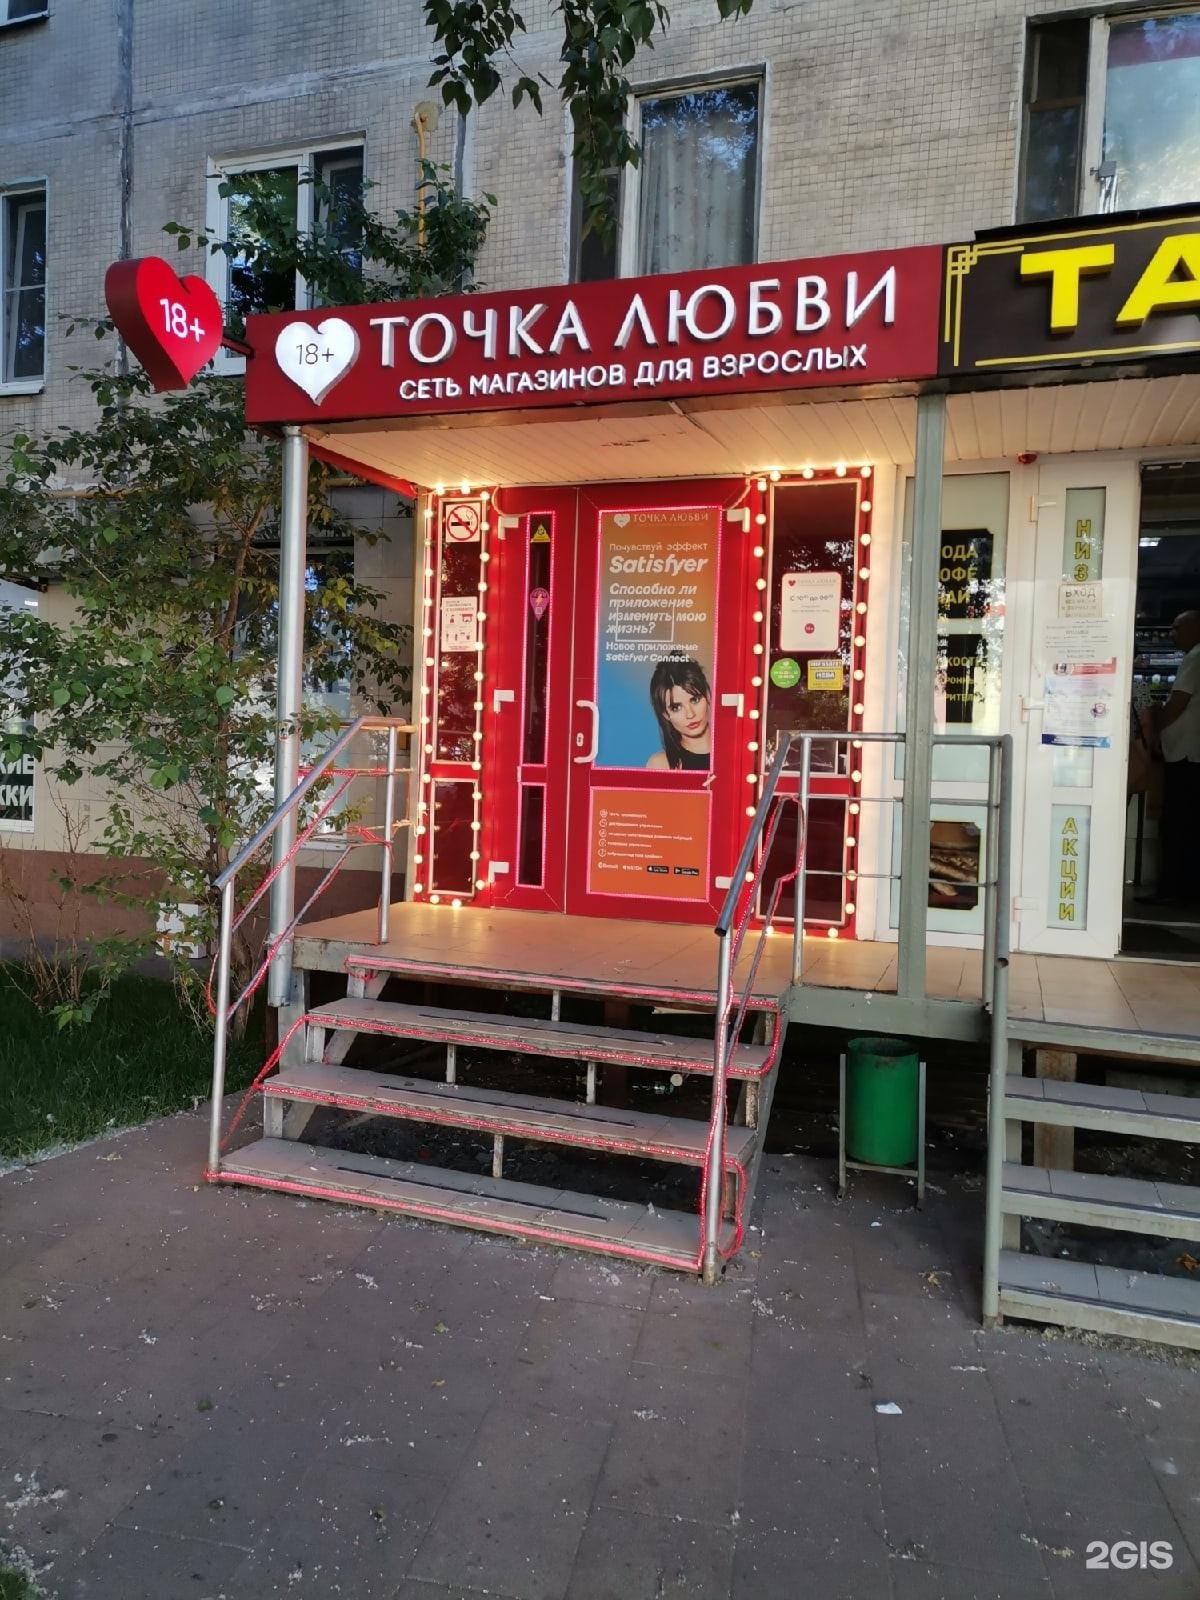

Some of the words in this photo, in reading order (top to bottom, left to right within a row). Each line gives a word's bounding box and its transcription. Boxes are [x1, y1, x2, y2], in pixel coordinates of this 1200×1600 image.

[160, 298, 206, 343] 18+
[369, 300, 592, 368] ТОЧКА
[614, 265, 897, 349] ЛЮБВИ
[296, 343, 335, 365] 18+
[400, 377, 461, 400] СЕТЬ
[469, 364, 625, 395] МАГАЗИНОВ
[633, 358, 693, 387] ДЛЯ
[703, 344, 868, 379] ВЗРОСЛЫХ
[633, 513, 667, 523] ТОЧКА
[669, 512, 709, 522] ЛЮБВИ
[609, 542, 662, 553] Почувствуй
[666, 541, 708, 553] эффект
[941, 545, 979, 561] ОДА
[609, 553, 709, 577] Satisfyer
[940, 566, 978, 581] ОФЕ
[609, 583, 676, 595] Способно
[678, 584, 698, 595] ли
[608, 598, 695, 609] приложение
[607, 611, 673, 622] изменить
[675, 611, 707, 622] мою
[606, 621, 656, 634] жизнь?
[605, 641, 636, 651] Новое
[1059, 817, 1078, 922] АКЦИИ
